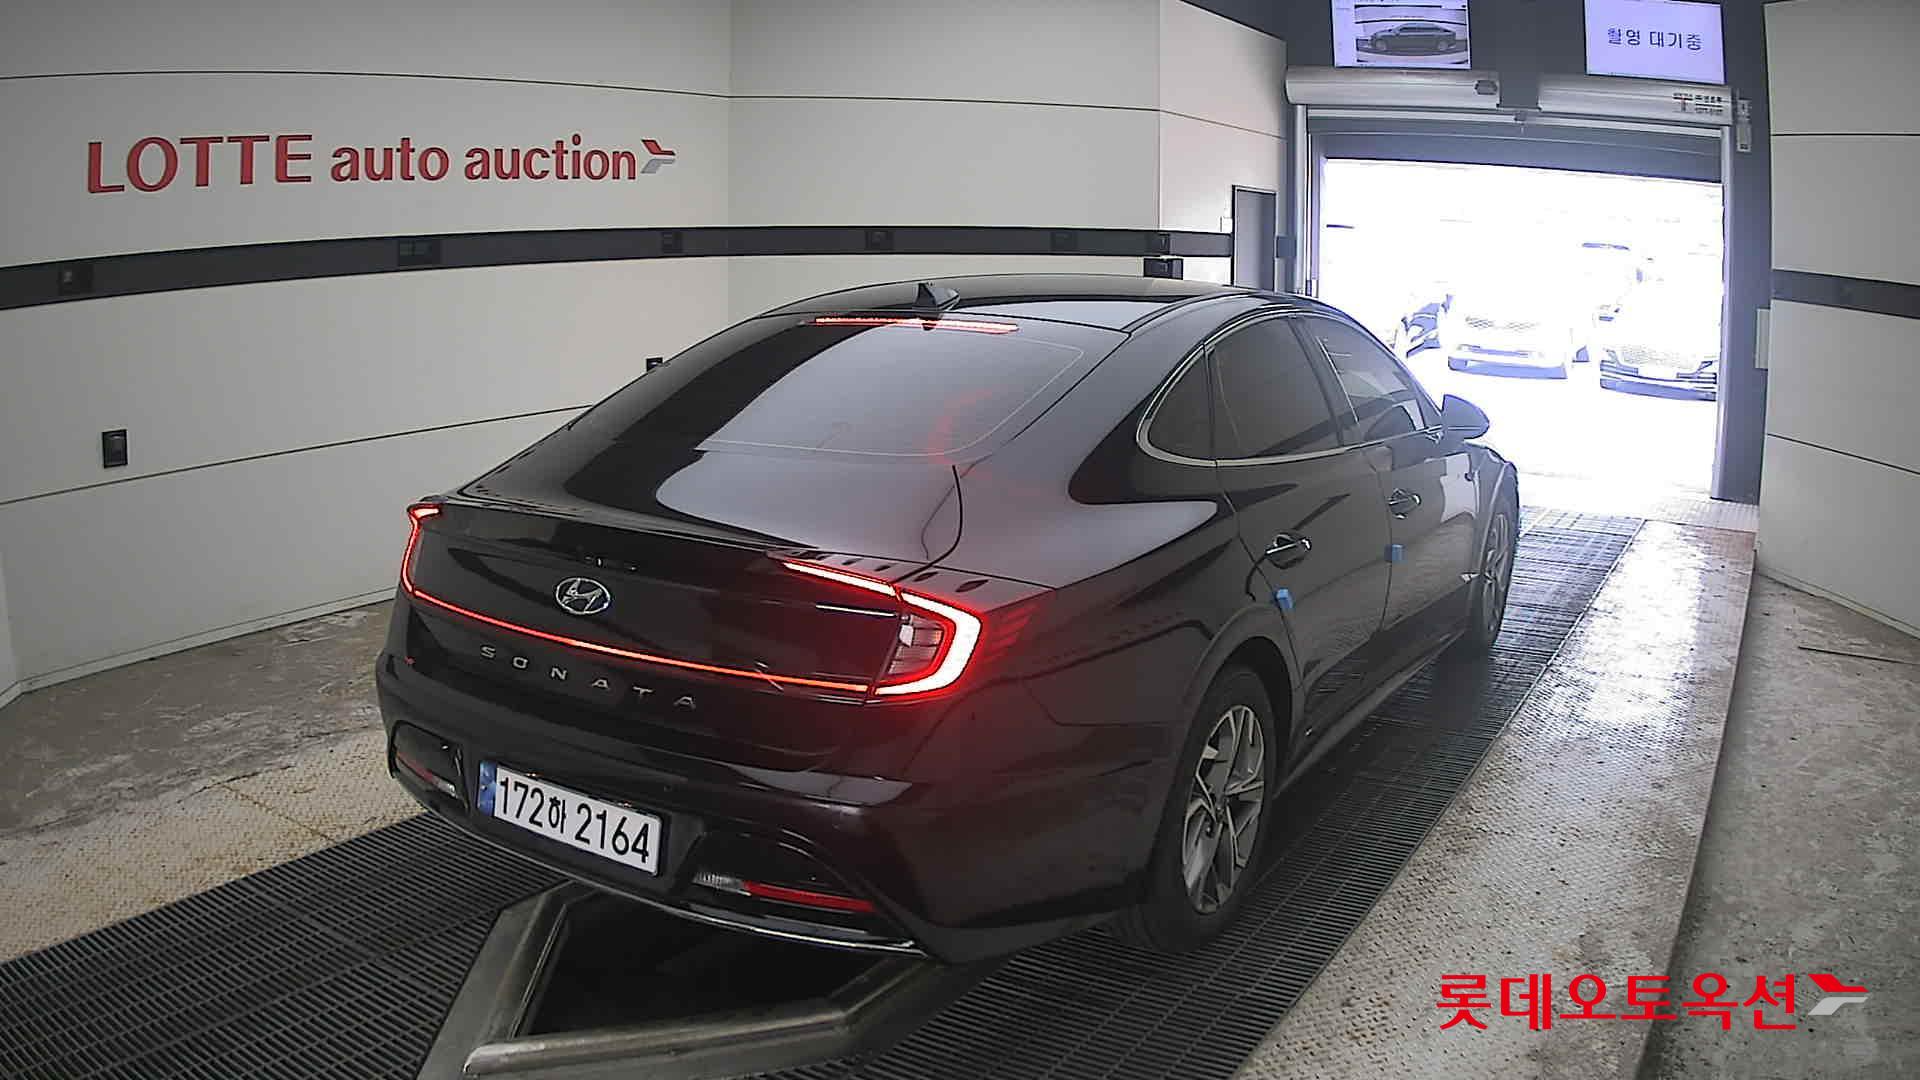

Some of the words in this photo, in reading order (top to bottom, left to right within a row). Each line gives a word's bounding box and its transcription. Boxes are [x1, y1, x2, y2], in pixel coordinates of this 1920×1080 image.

[86, 134, 313, 194] LOTTE
[330, 137, 450, 182] auto
[463, 133, 637, 182] auction
[480, 645, 697, 710] SONATA
